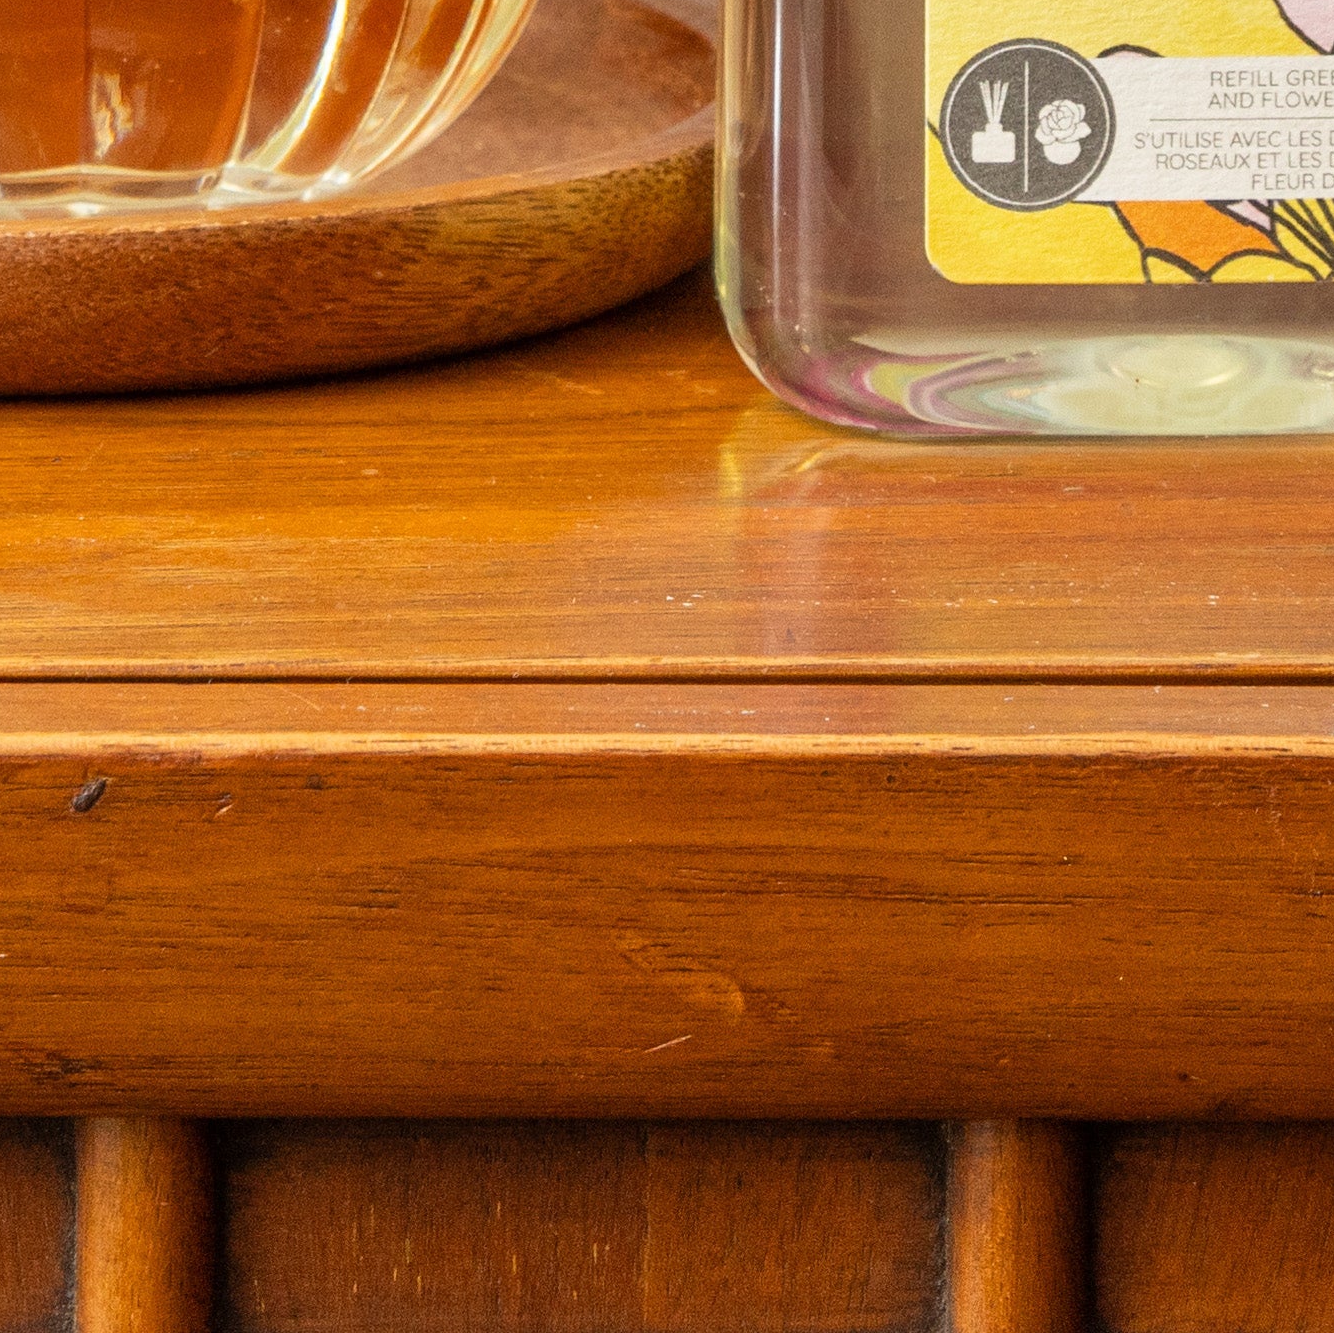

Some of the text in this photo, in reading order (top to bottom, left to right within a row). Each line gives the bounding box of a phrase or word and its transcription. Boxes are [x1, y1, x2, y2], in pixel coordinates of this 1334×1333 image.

[1210, 70, 1279, 87] REFILL
[1208, 91, 1254, 109] AND
[1229, 131, 1282, 148] AVEC
[1288, 130, 1323, 147] LES
[1155, 152, 1251, 170] ROSEAUX
[1258, 152, 1282, 169] ET
[1288, 151, 1323, 169] LES
[1251, 173, 1315, 191] FLEUR
